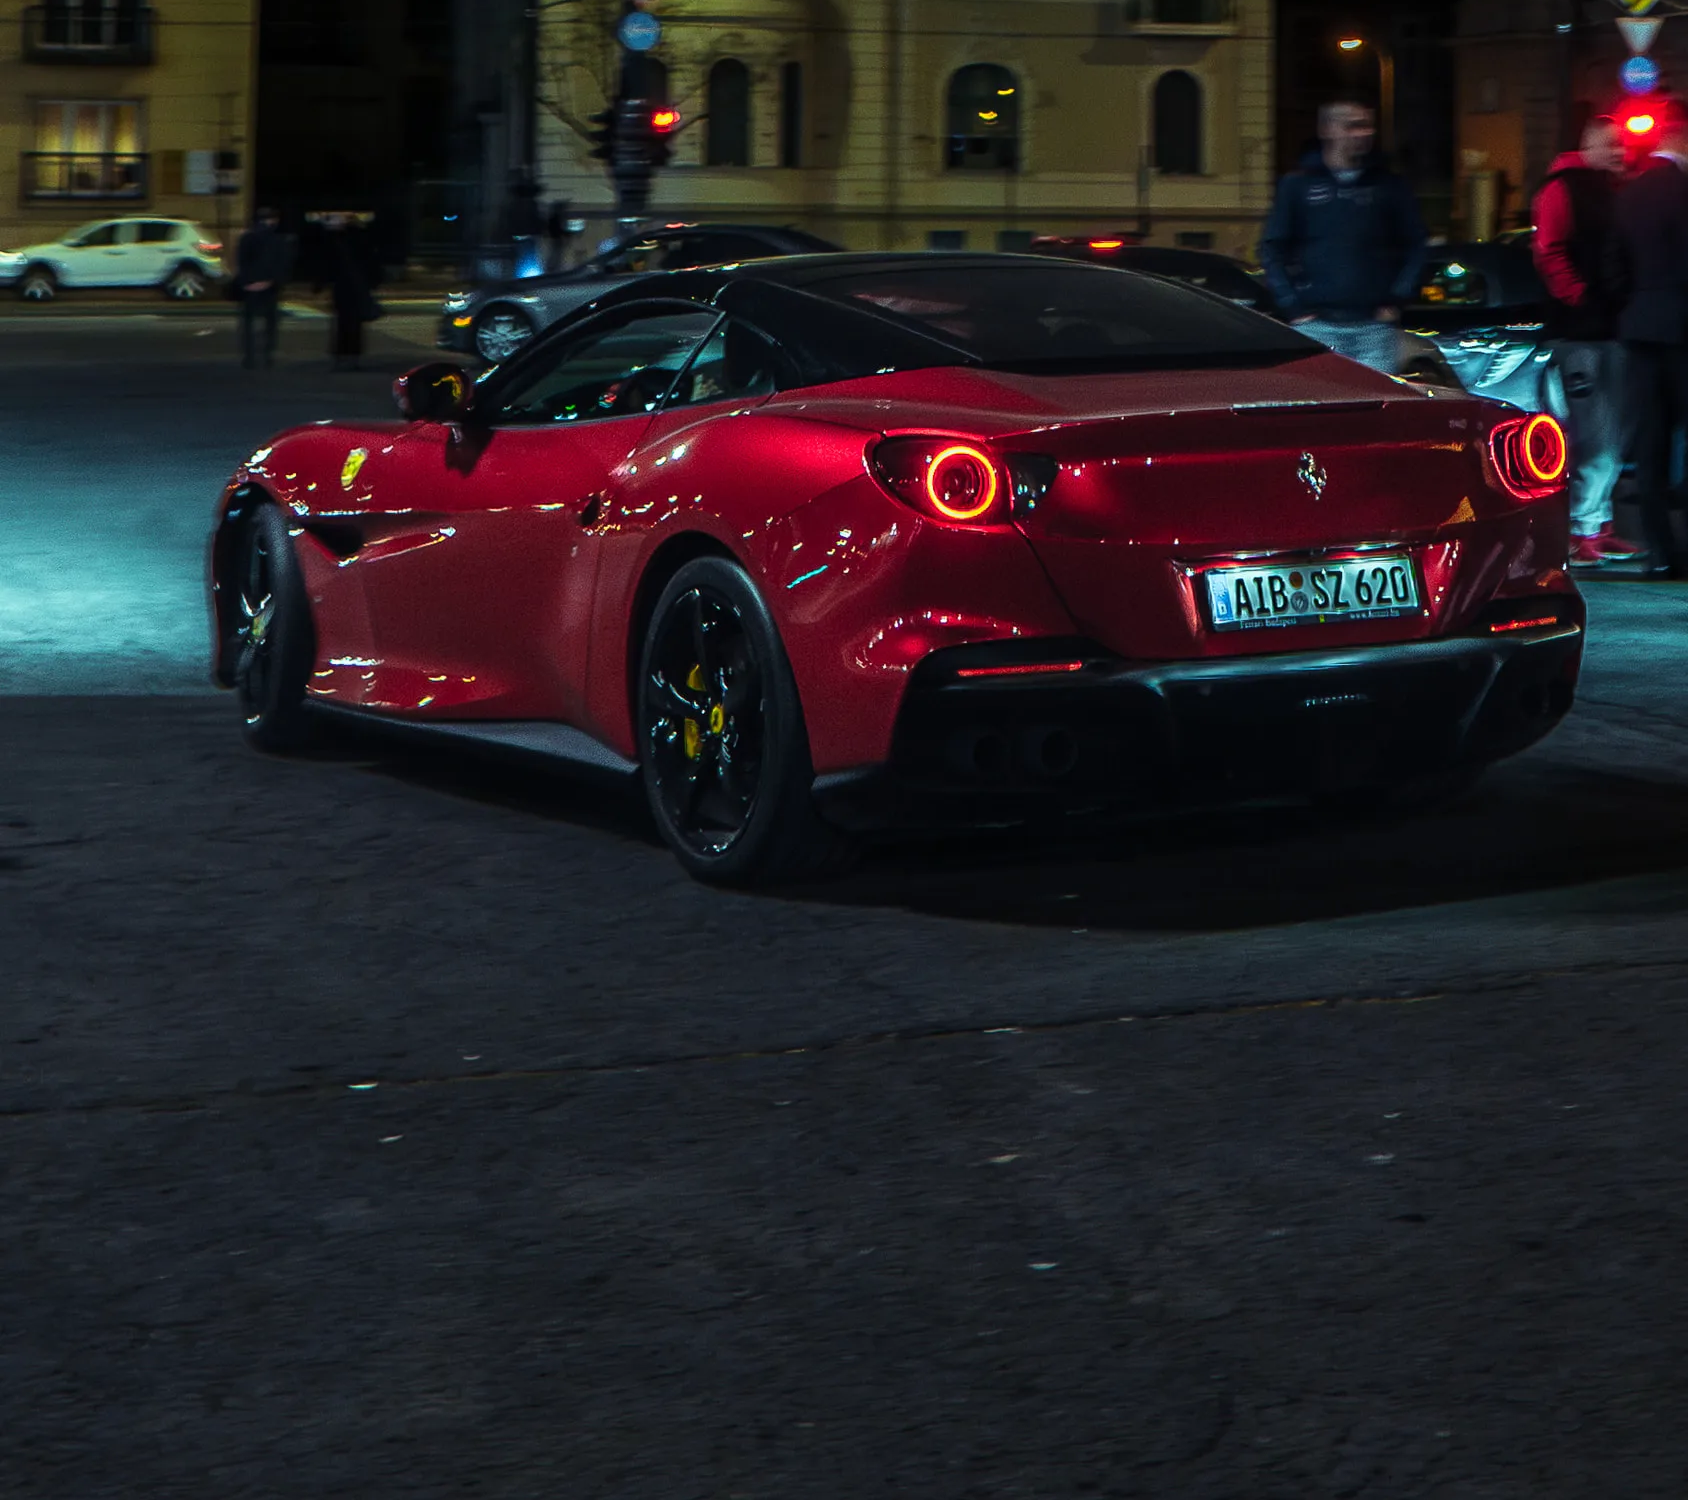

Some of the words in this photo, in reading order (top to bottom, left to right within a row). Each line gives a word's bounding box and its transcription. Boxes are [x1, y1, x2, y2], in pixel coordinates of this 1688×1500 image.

[1235, 575, 1289, 618] AIB
[1310, 570, 1350, 610] SZ
[1355, 566, 1409, 606] 620
